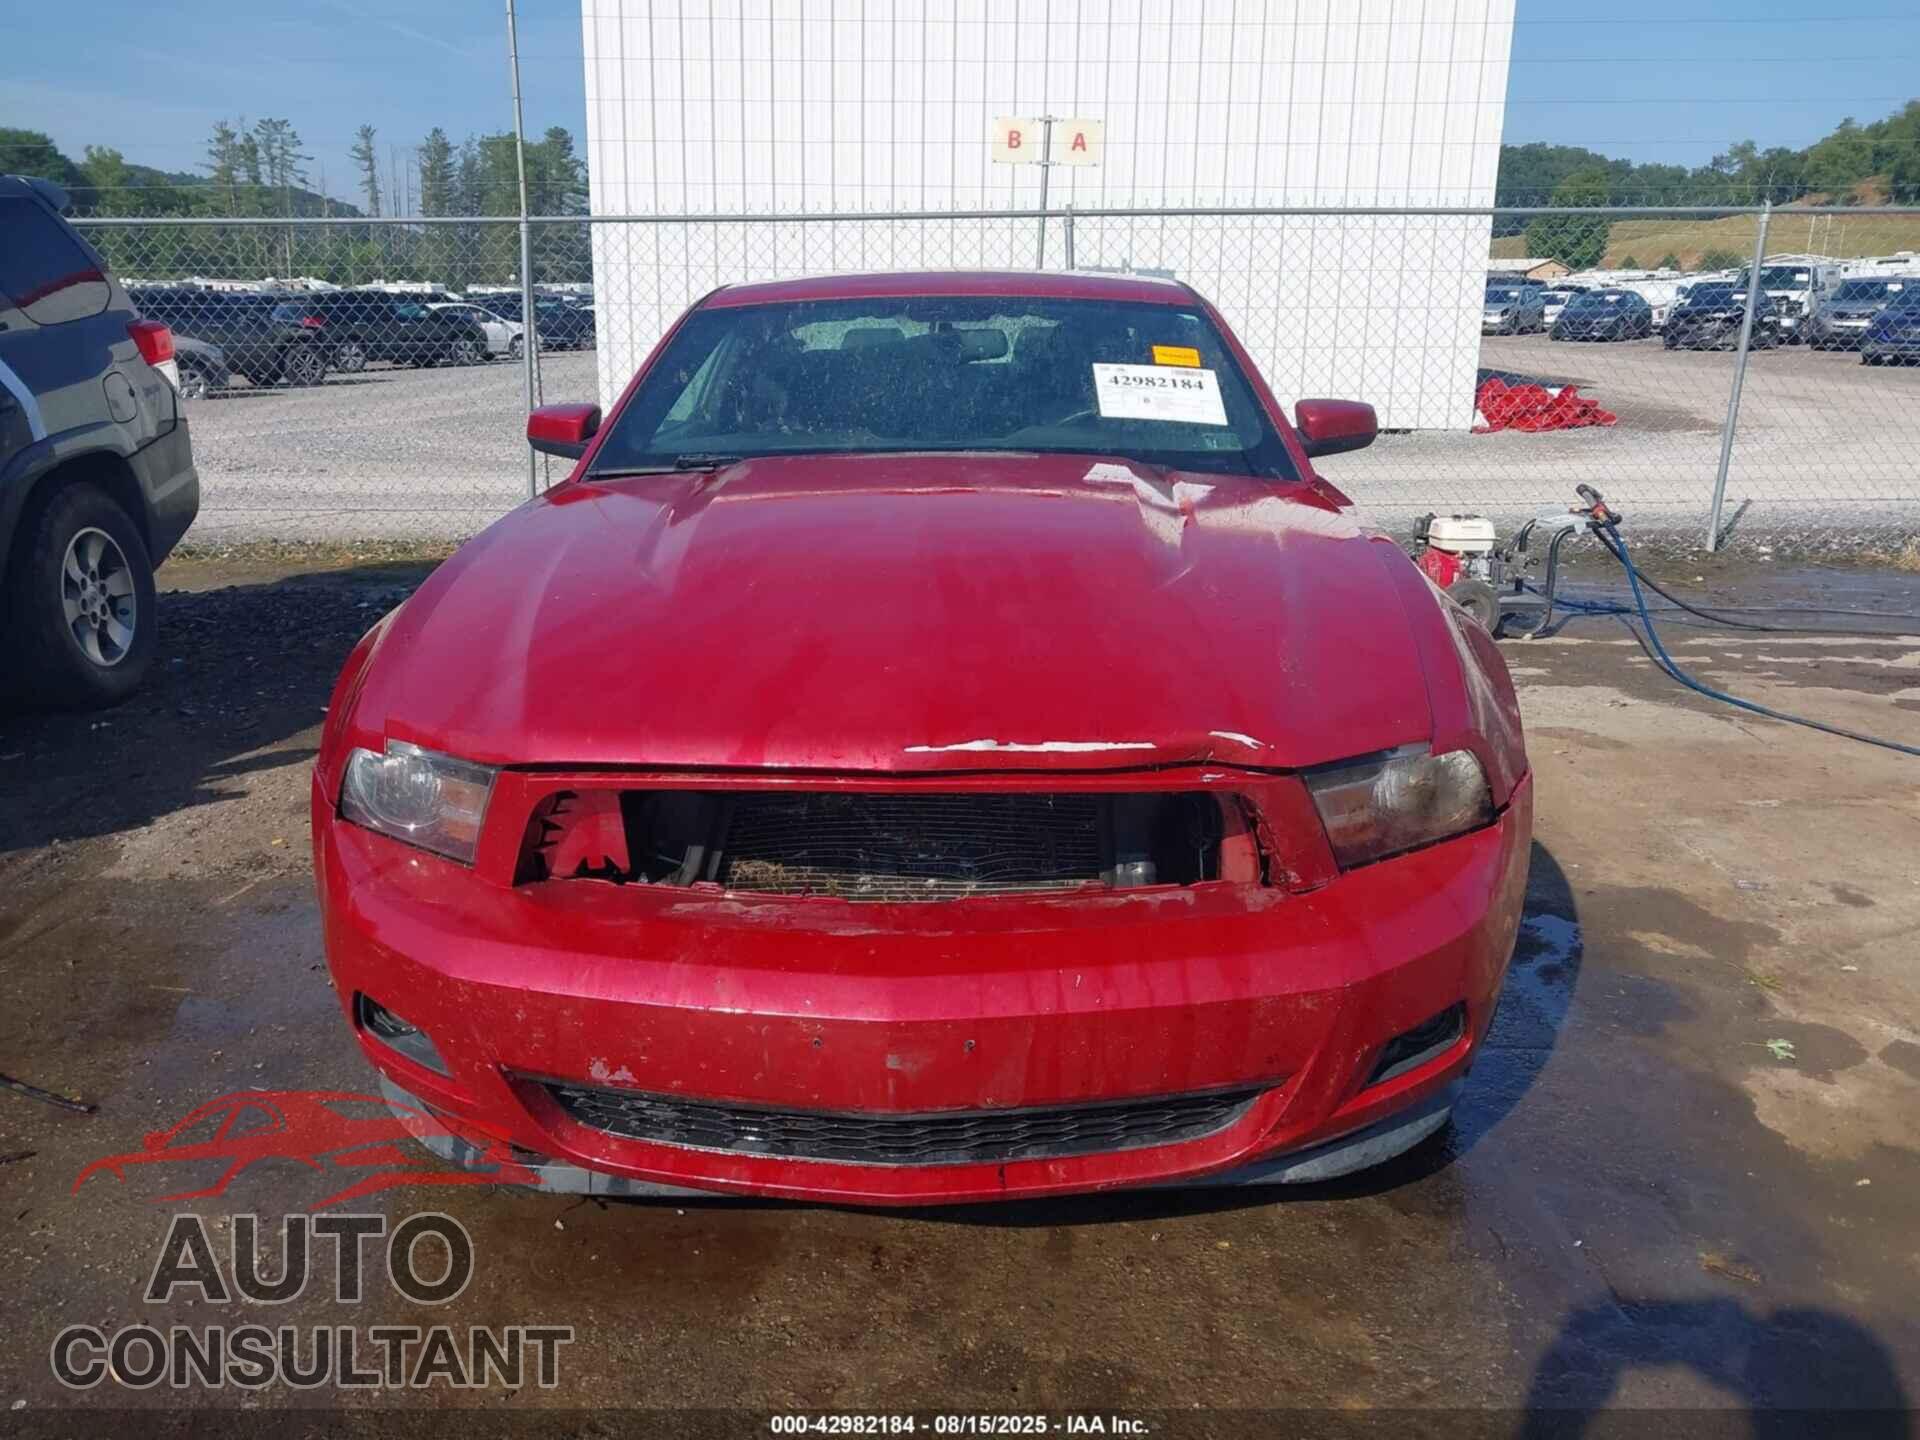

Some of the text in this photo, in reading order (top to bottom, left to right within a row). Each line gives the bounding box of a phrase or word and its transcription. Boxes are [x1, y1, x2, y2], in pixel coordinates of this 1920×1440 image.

[1007, 130, 1022, 149] B
[1071, 132, 1087, 152] A
[1108, 375, 1205, 391] 42982184
